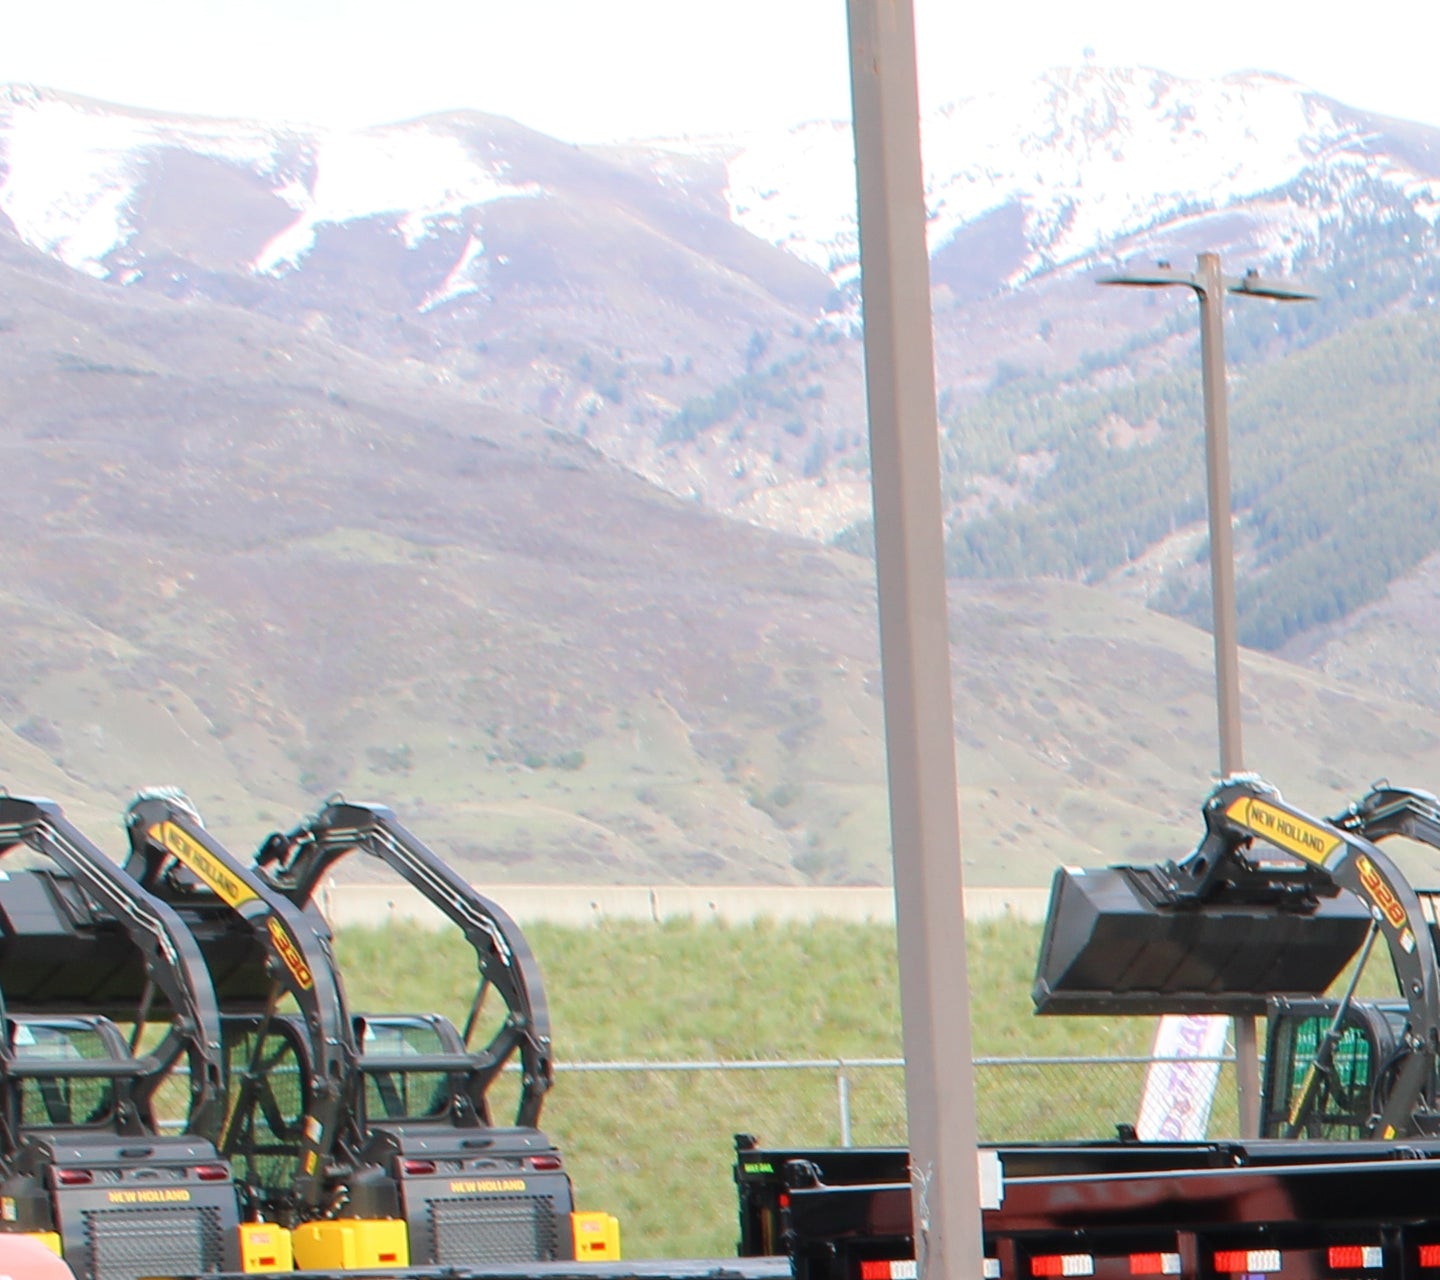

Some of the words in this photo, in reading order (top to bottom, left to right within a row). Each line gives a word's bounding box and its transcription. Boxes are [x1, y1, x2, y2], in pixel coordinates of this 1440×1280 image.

[1251, 806, 1275, 829] NEW
[1276, 816, 1326, 854] HOLLAND
[476, 1180, 526, 1192] HOLLAND
[138, 1189, 191, 1202] HOLLAND
